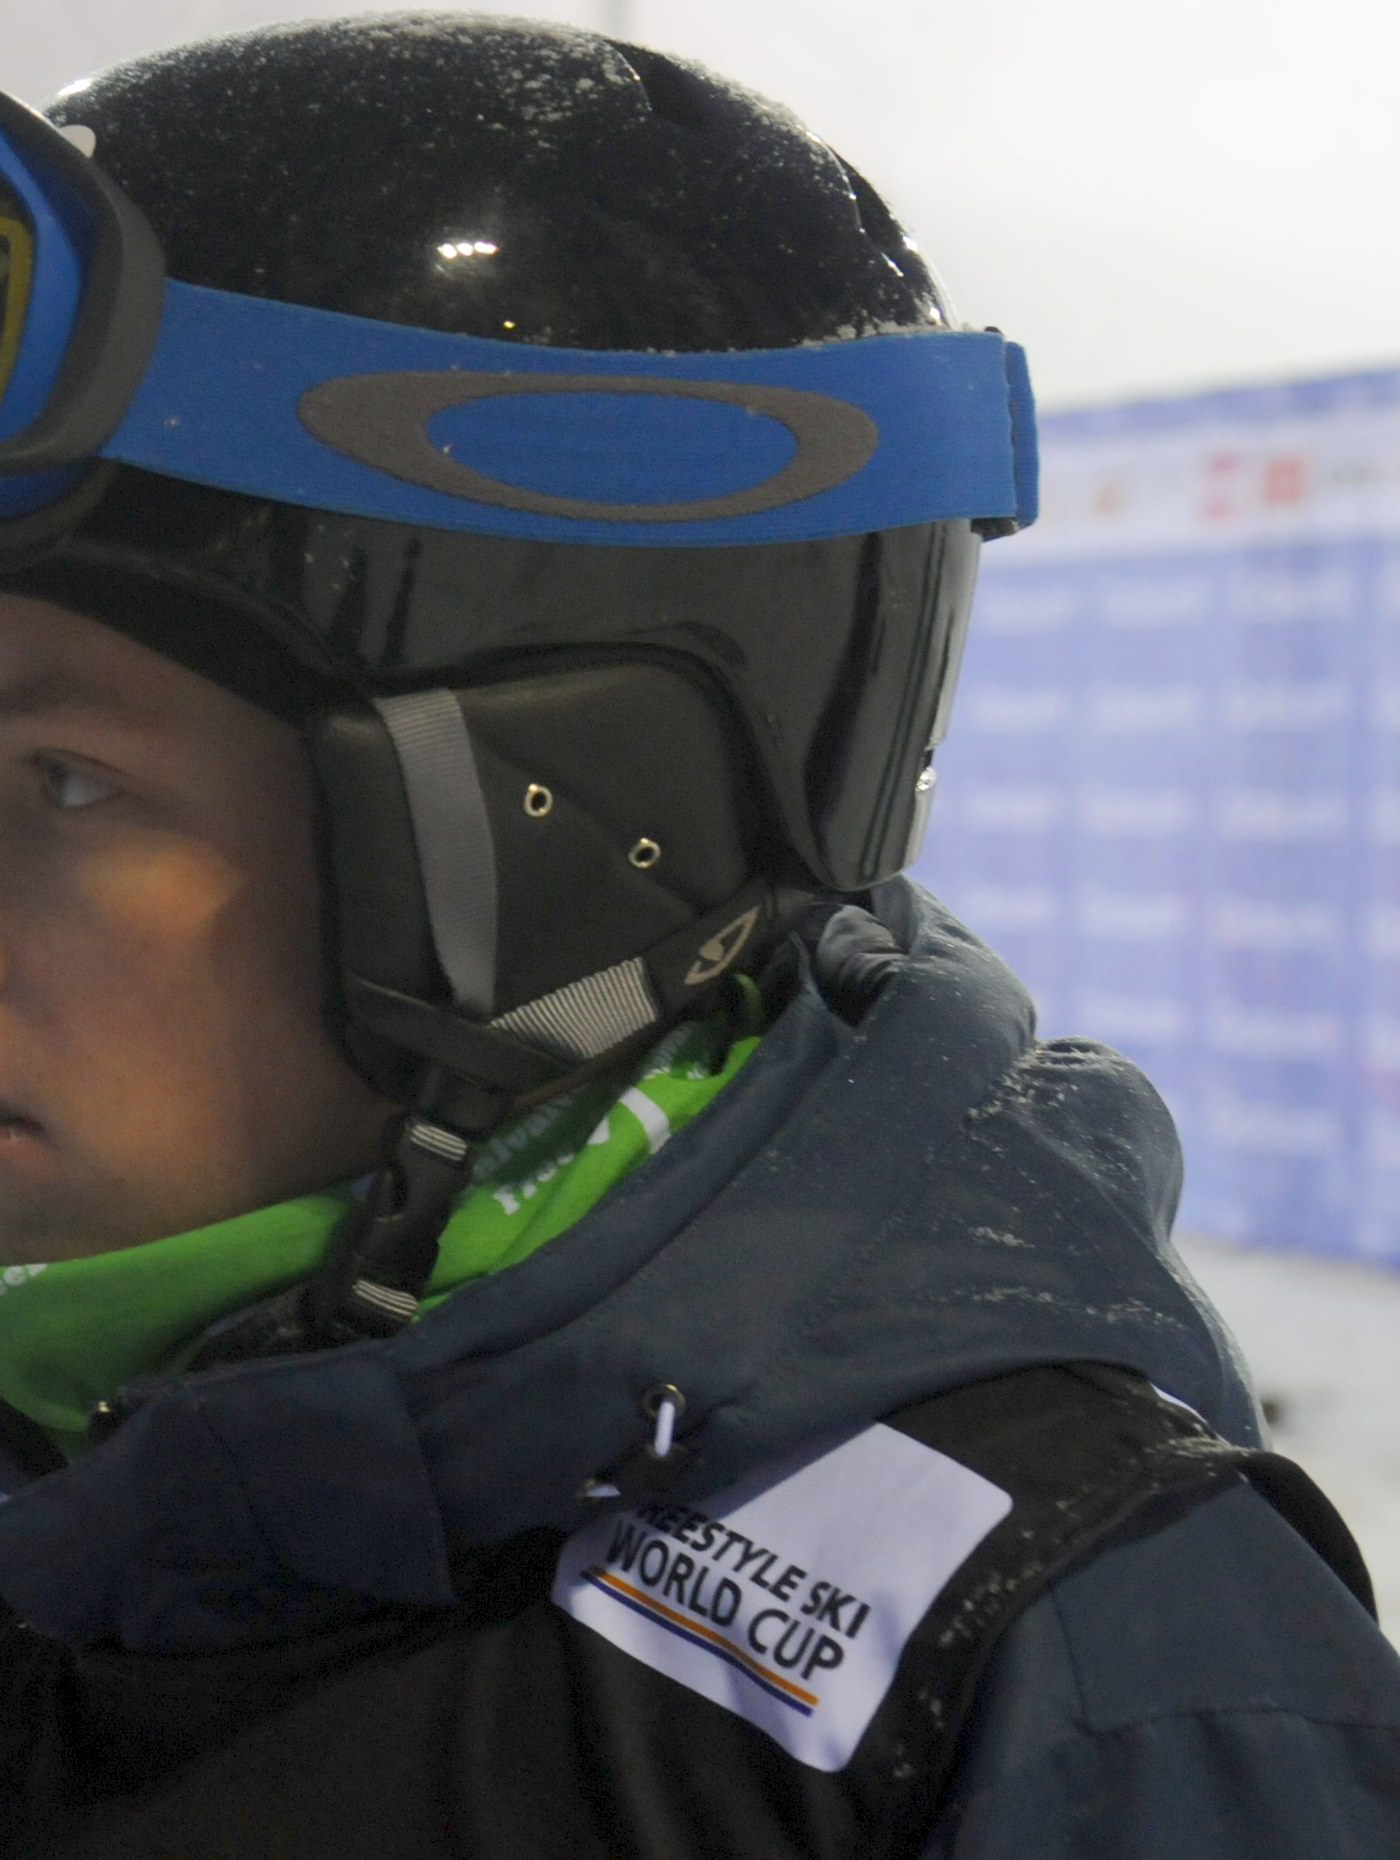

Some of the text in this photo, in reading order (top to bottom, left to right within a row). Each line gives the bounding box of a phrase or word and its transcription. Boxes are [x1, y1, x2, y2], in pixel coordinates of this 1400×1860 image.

[605, 1519, 845, 1681] WORLD CUP
[801, 1581, 871, 1639] SKI
